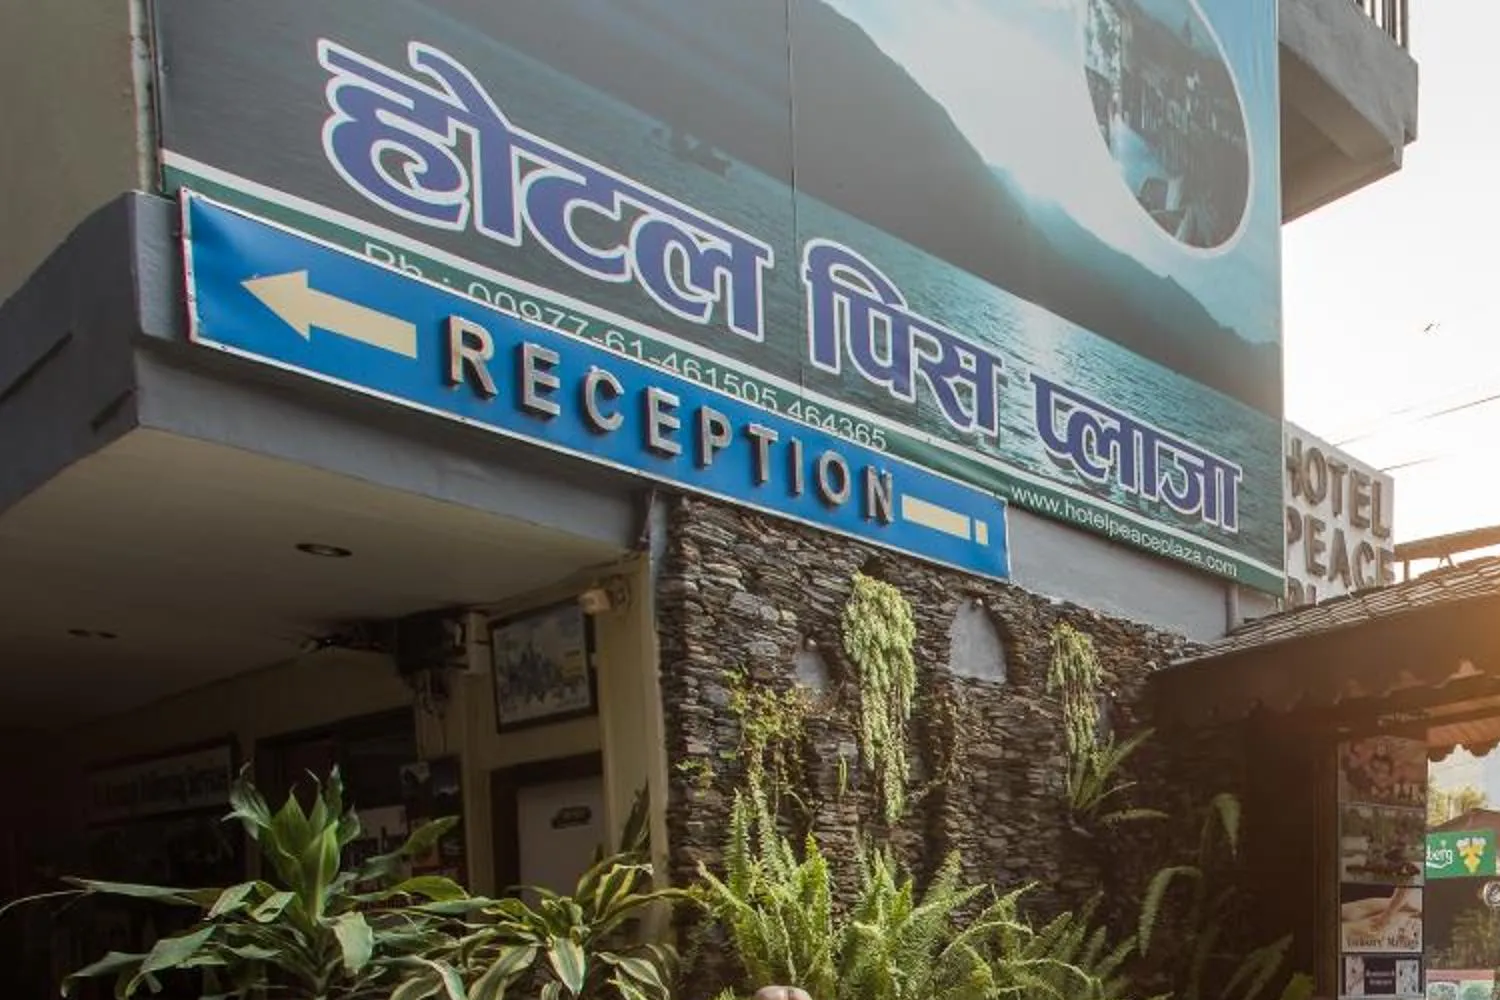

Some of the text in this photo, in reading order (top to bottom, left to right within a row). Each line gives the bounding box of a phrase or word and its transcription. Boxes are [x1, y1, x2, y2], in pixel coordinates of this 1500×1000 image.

[317, 38, 1243, 533] होटल पिस प्लाजा
[447, 313, 895, 525] RECEPTION
[1011, 486, 1238, 577] www.hotelpeaceplaza.com
